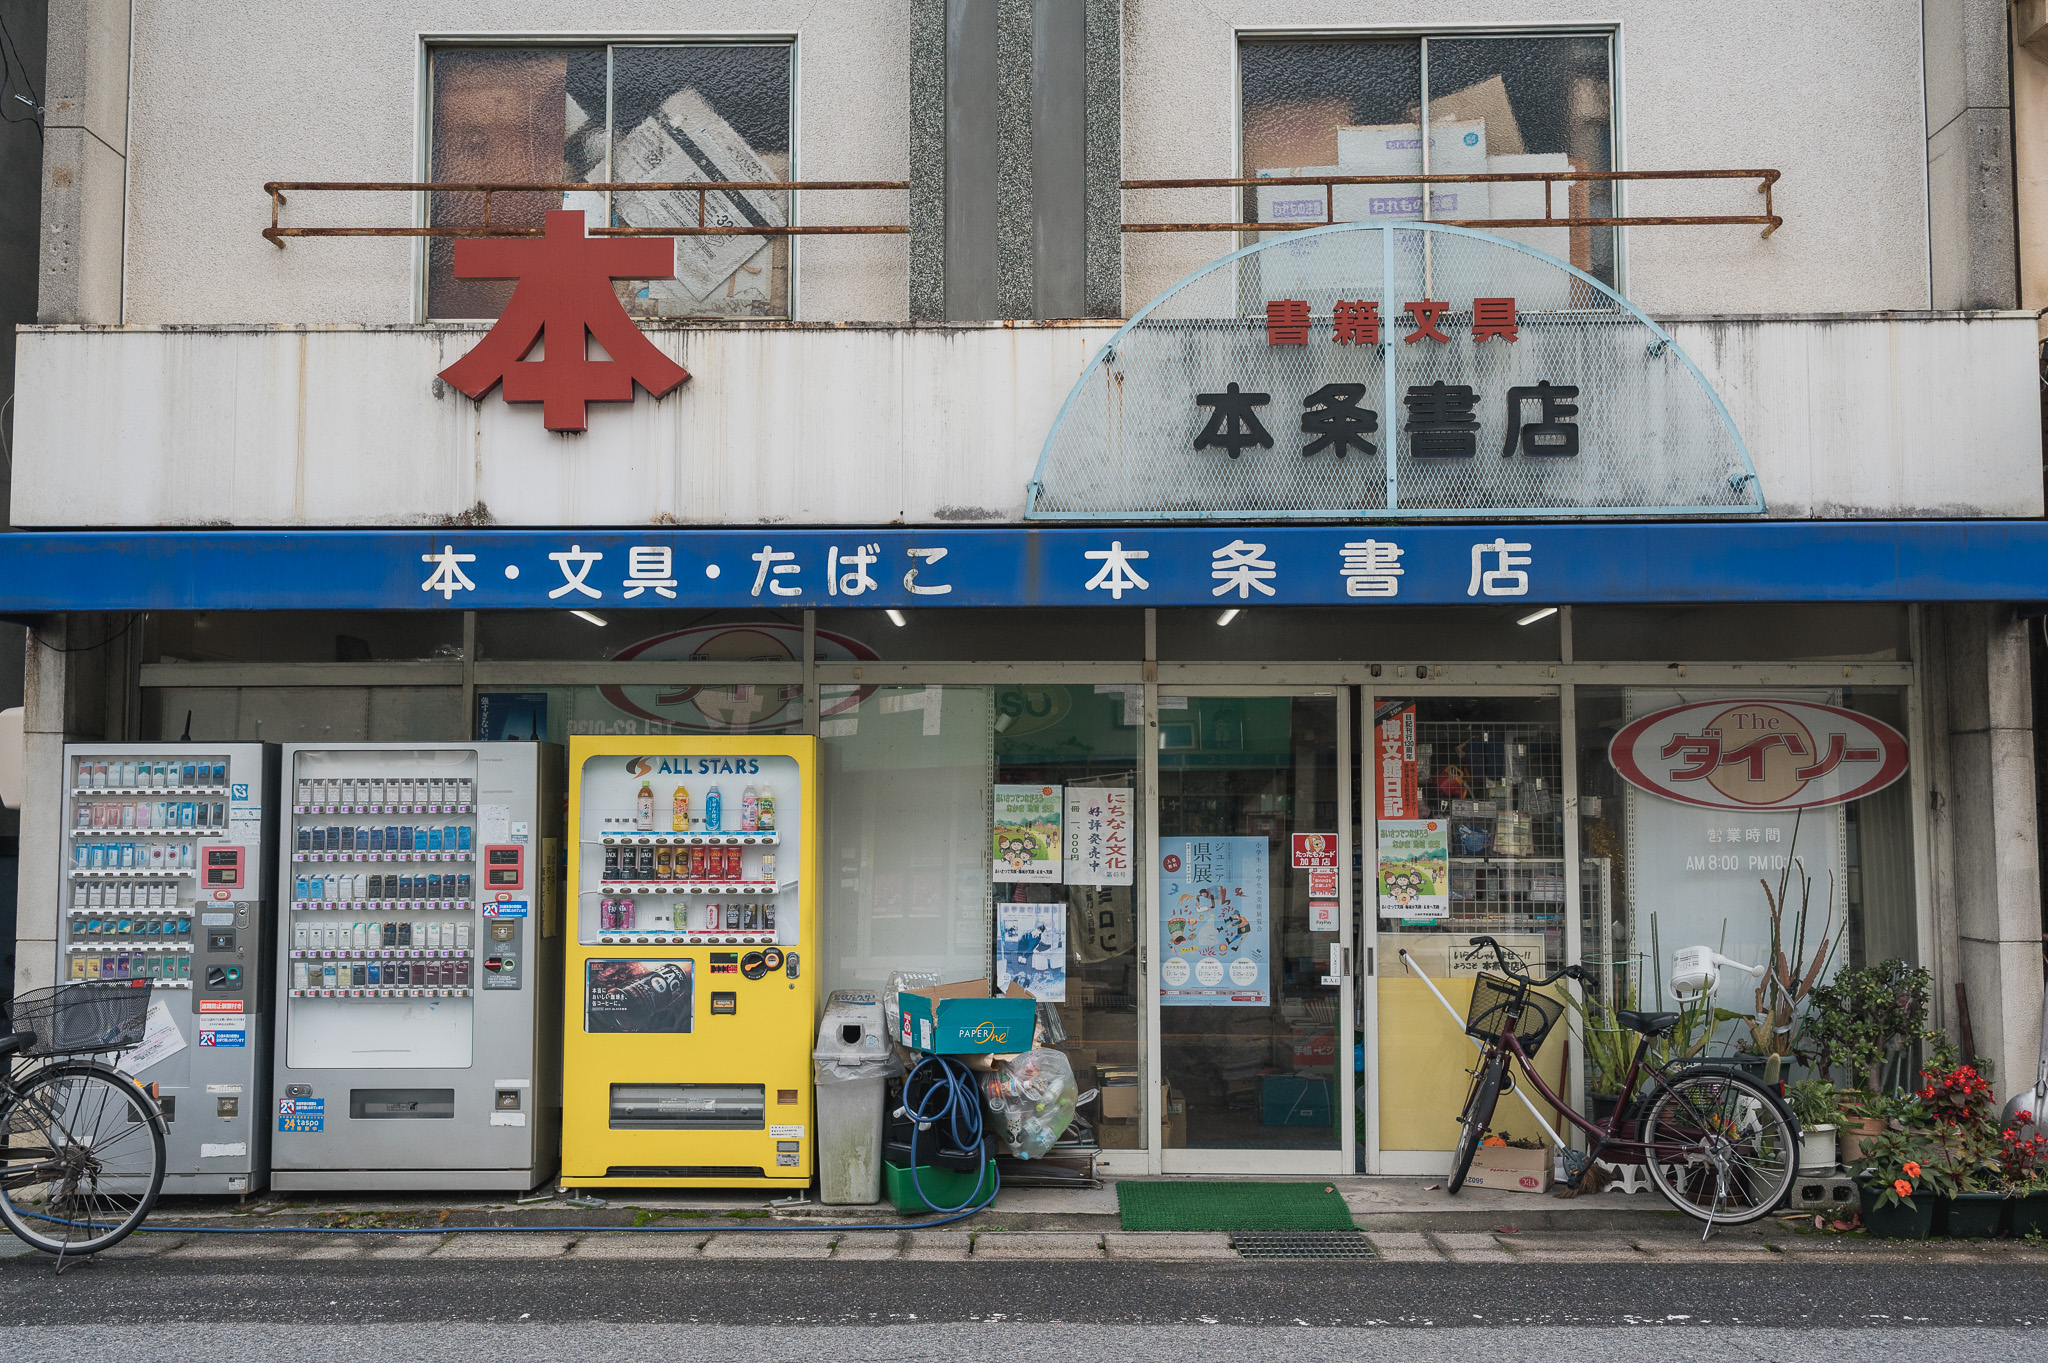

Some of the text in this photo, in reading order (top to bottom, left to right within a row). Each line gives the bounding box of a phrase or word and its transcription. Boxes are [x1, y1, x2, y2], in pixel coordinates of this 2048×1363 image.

[437, 210, 692, 432] 本
[1266, 297, 1519, 345] 書籍文具
[1193, 380, 1580, 459] 本条書店
[1084, 537, 1532, 599] 本条書店
[1731, 713, 1780, 730] The
[658, 758, 759, 775] ALL STARS
[1382, 719, 1404, 817] 博文館日記
[1661, 729, 1880, 781] ダイソー
[1087, 806, 1102, 873] 好評発売中
[1105, 793, 1128, 869] にちなん文化
[1707, 827, 1781, 843] 営業時間
[1193, 842, 1212, 883] 県展
[1215, 842, 1225, 883] ジュニア
[1295, 850, 1336, 858] たったもカード
[1300, 858, 1330, 866] 加盟店
[1453, 962, 1478, 970] ようこそ
[959, 1021, 1009, 1044] PAPER One
[284, 1118, 319, 1128] 24 taspo
